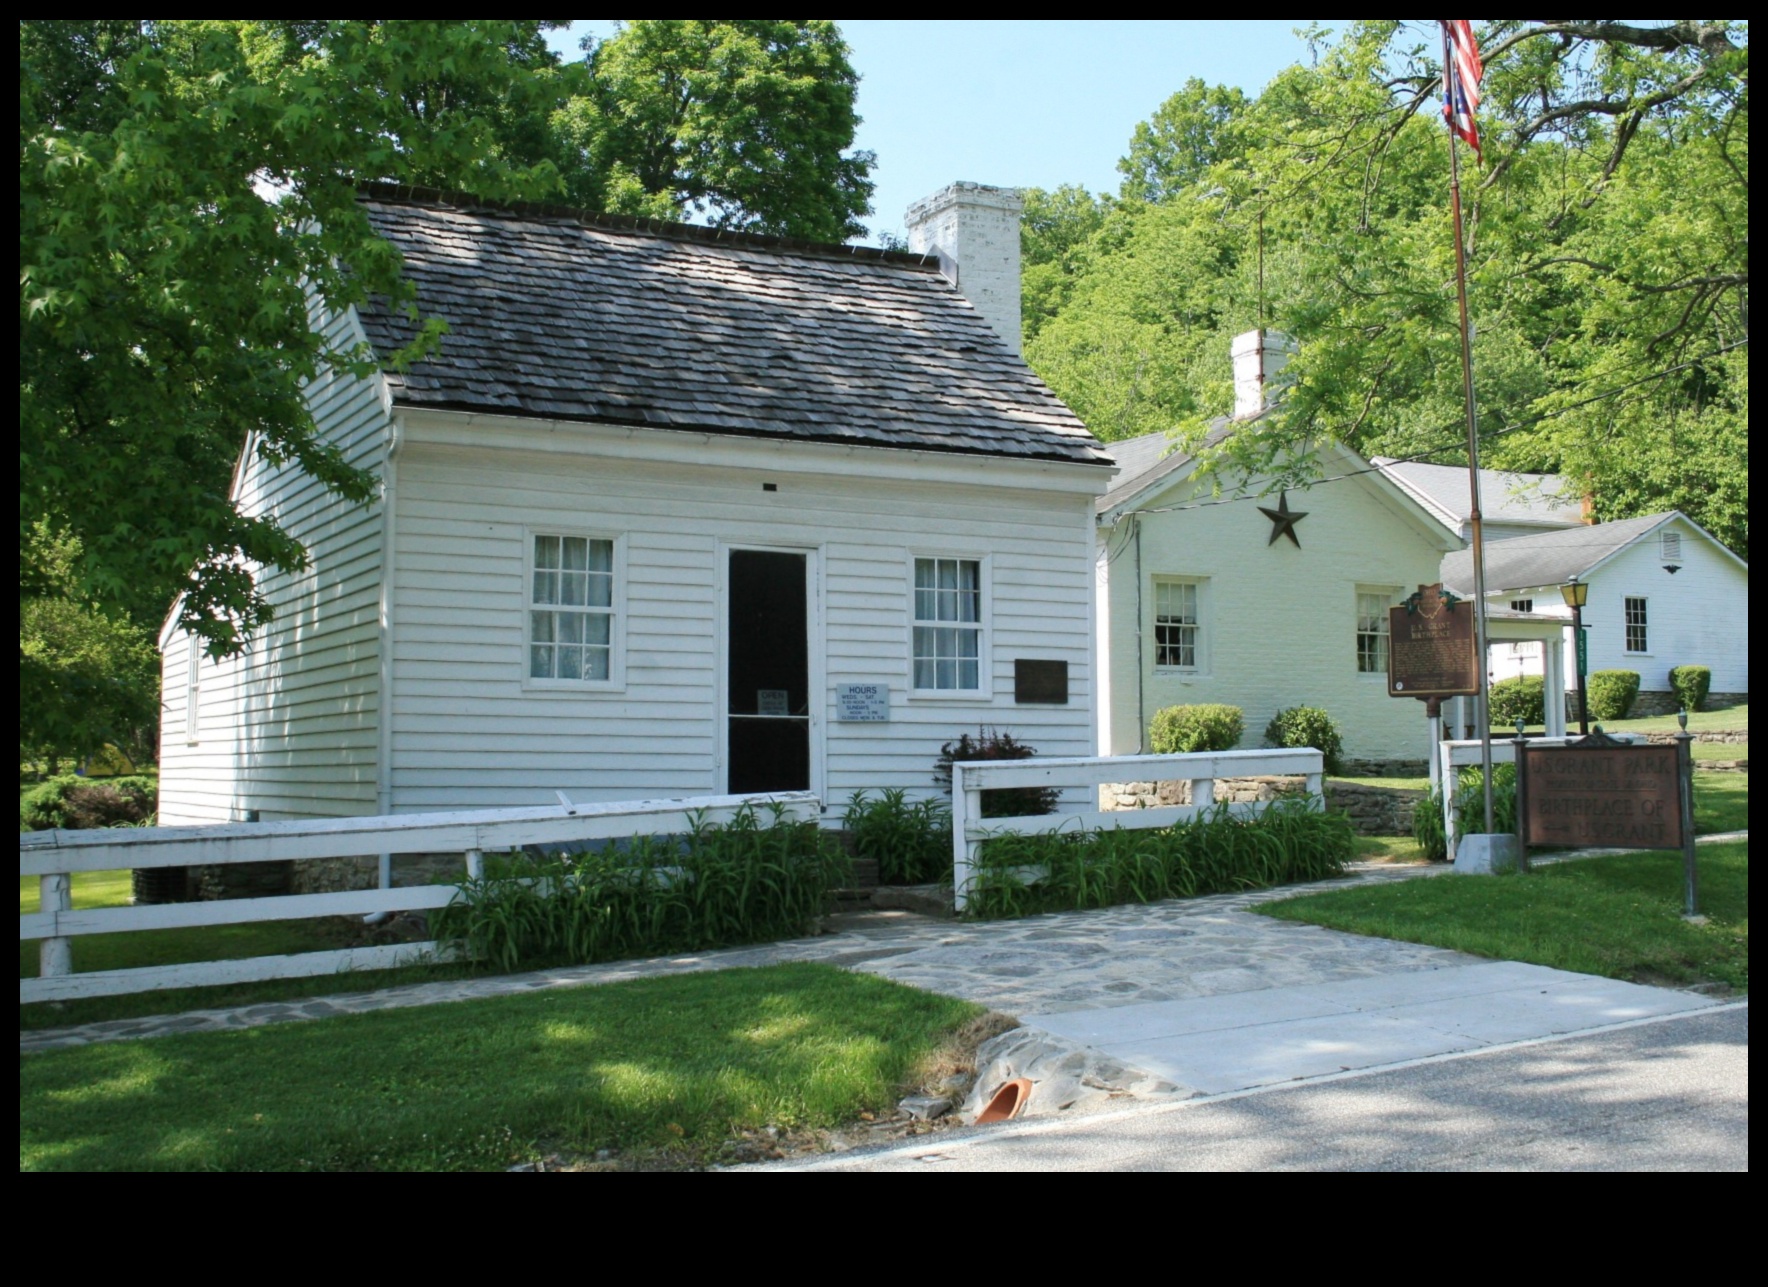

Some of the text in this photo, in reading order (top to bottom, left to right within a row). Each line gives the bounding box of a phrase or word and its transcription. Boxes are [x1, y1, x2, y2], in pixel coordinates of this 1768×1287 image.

[761, 691, 785, 699] OPEN
[849, 686, 877, 694] HOURS
[1623, 756, 1672, 774] PARK
[1539, 798, 1665, 817] BIRTHPLACE OF
